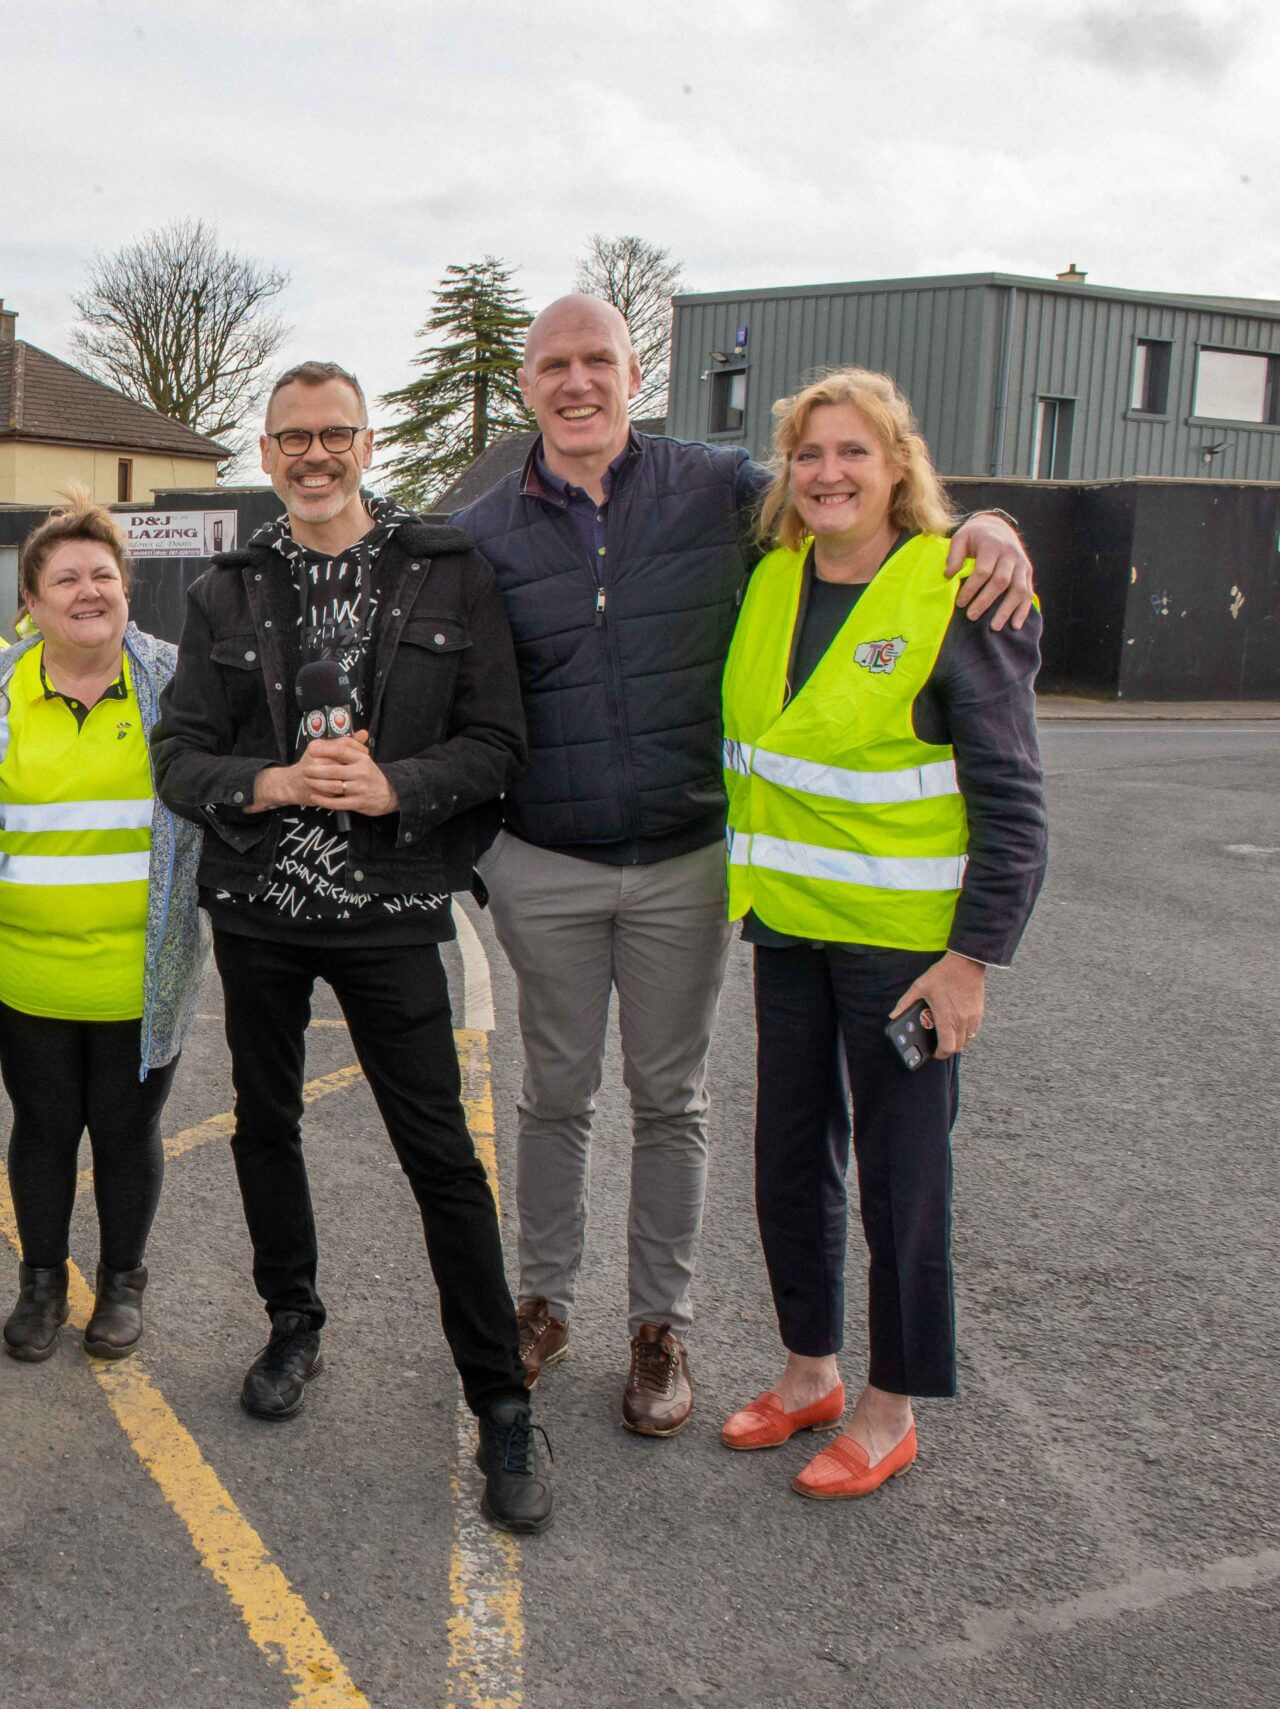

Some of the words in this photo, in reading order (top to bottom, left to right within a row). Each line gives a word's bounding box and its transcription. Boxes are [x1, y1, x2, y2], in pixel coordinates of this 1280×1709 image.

[131, 516, 171, 526] D&J
[127, 528, 197, 539] LAZING
[867, 642, 894, 668] TLC
[275, 855, 318, 886] JOHN
